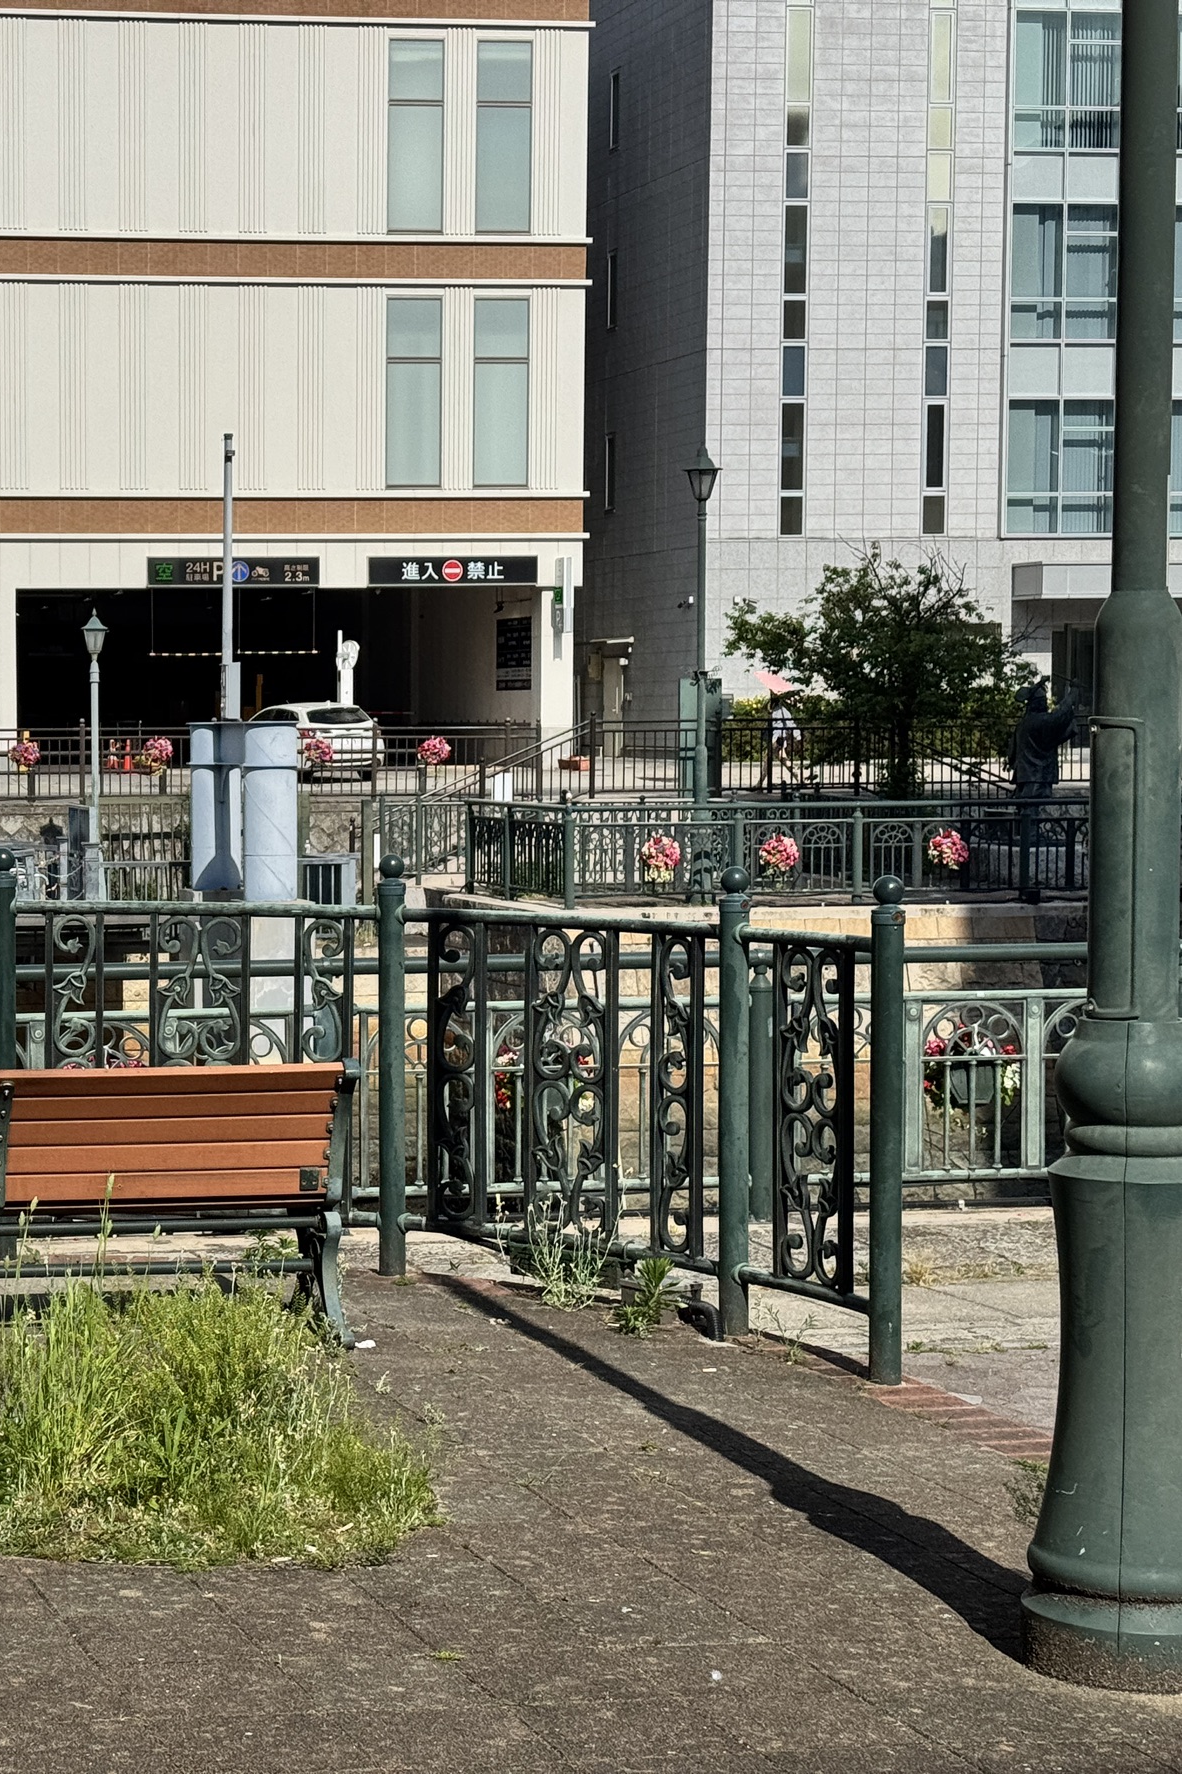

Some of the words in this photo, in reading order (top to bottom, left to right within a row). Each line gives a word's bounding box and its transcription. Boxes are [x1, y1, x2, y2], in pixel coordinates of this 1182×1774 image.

[155, 562, 174, 581] 空
[185, 561, 210, 573] 24H
[401, 561, 439, 580] 進入
[467, 561, 505, 580] 禁止
[284, 571, 310, 582] 2.3m
